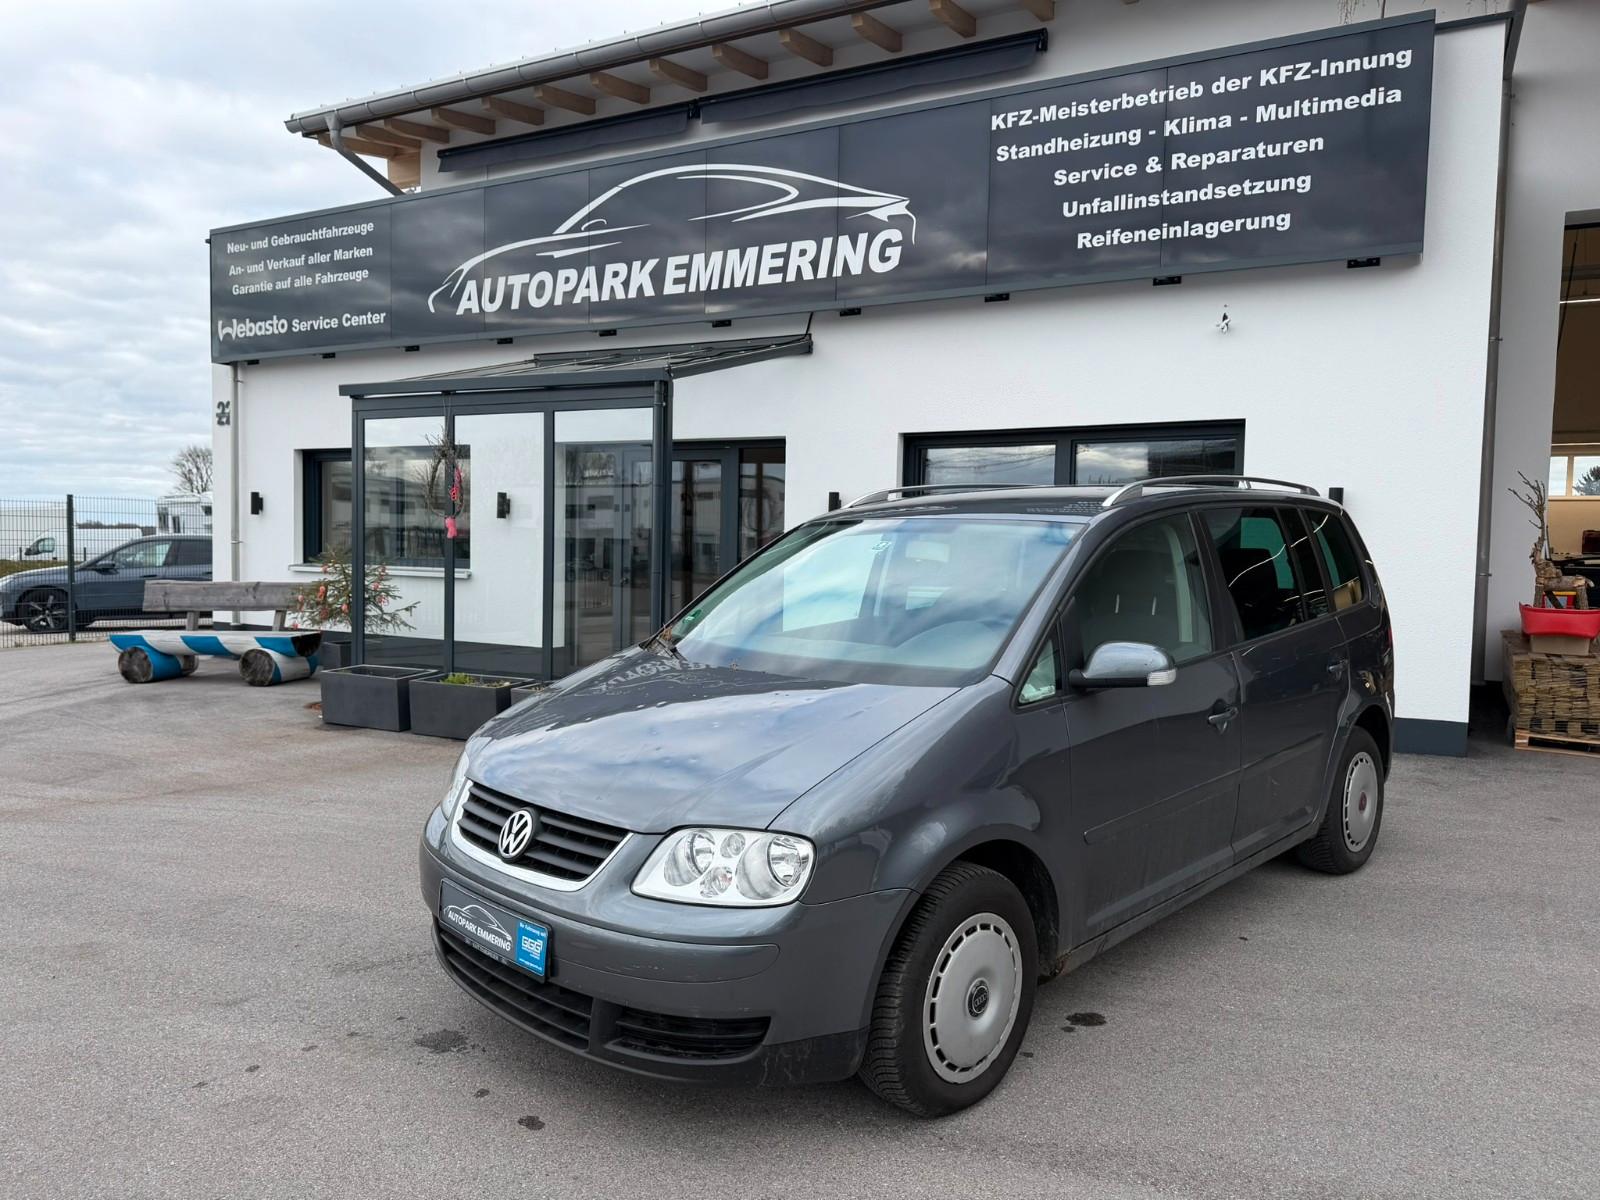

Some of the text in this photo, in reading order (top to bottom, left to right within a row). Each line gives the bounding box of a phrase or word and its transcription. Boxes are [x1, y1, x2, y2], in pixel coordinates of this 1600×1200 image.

[992, 50, 1411, 130] KFZ-Meisterbetrieb der KFZ-Innung
[997, 129, 1141, 161] Standheizung
[1164, 115, 1231, 136] Klima
[1256, 87, 1401, 122] Multimedia
[1054, 138, 1323, 185] Service & Reparaturen
[1063, 175, 1311, 217] Unfallinstandsetzung
[227, 223, 374, 253] Neu- und Gebrauchtfahrzeuge
[1078, 214, 1290, 248] Reifeneinlagerung
[229, 247, 372, 276] An- und Verkauf aller Marken
[455, 229, 902, 315] AUTOPARK EMMERING
[233, 270, 368, 295] Garantie auf alle Fahrzeuge
[218, 312, 386, 341] Webasto Service Center
[448, 910, 477, 934] AUTOPARK
[476, 926, 512, 951] EMMERING
